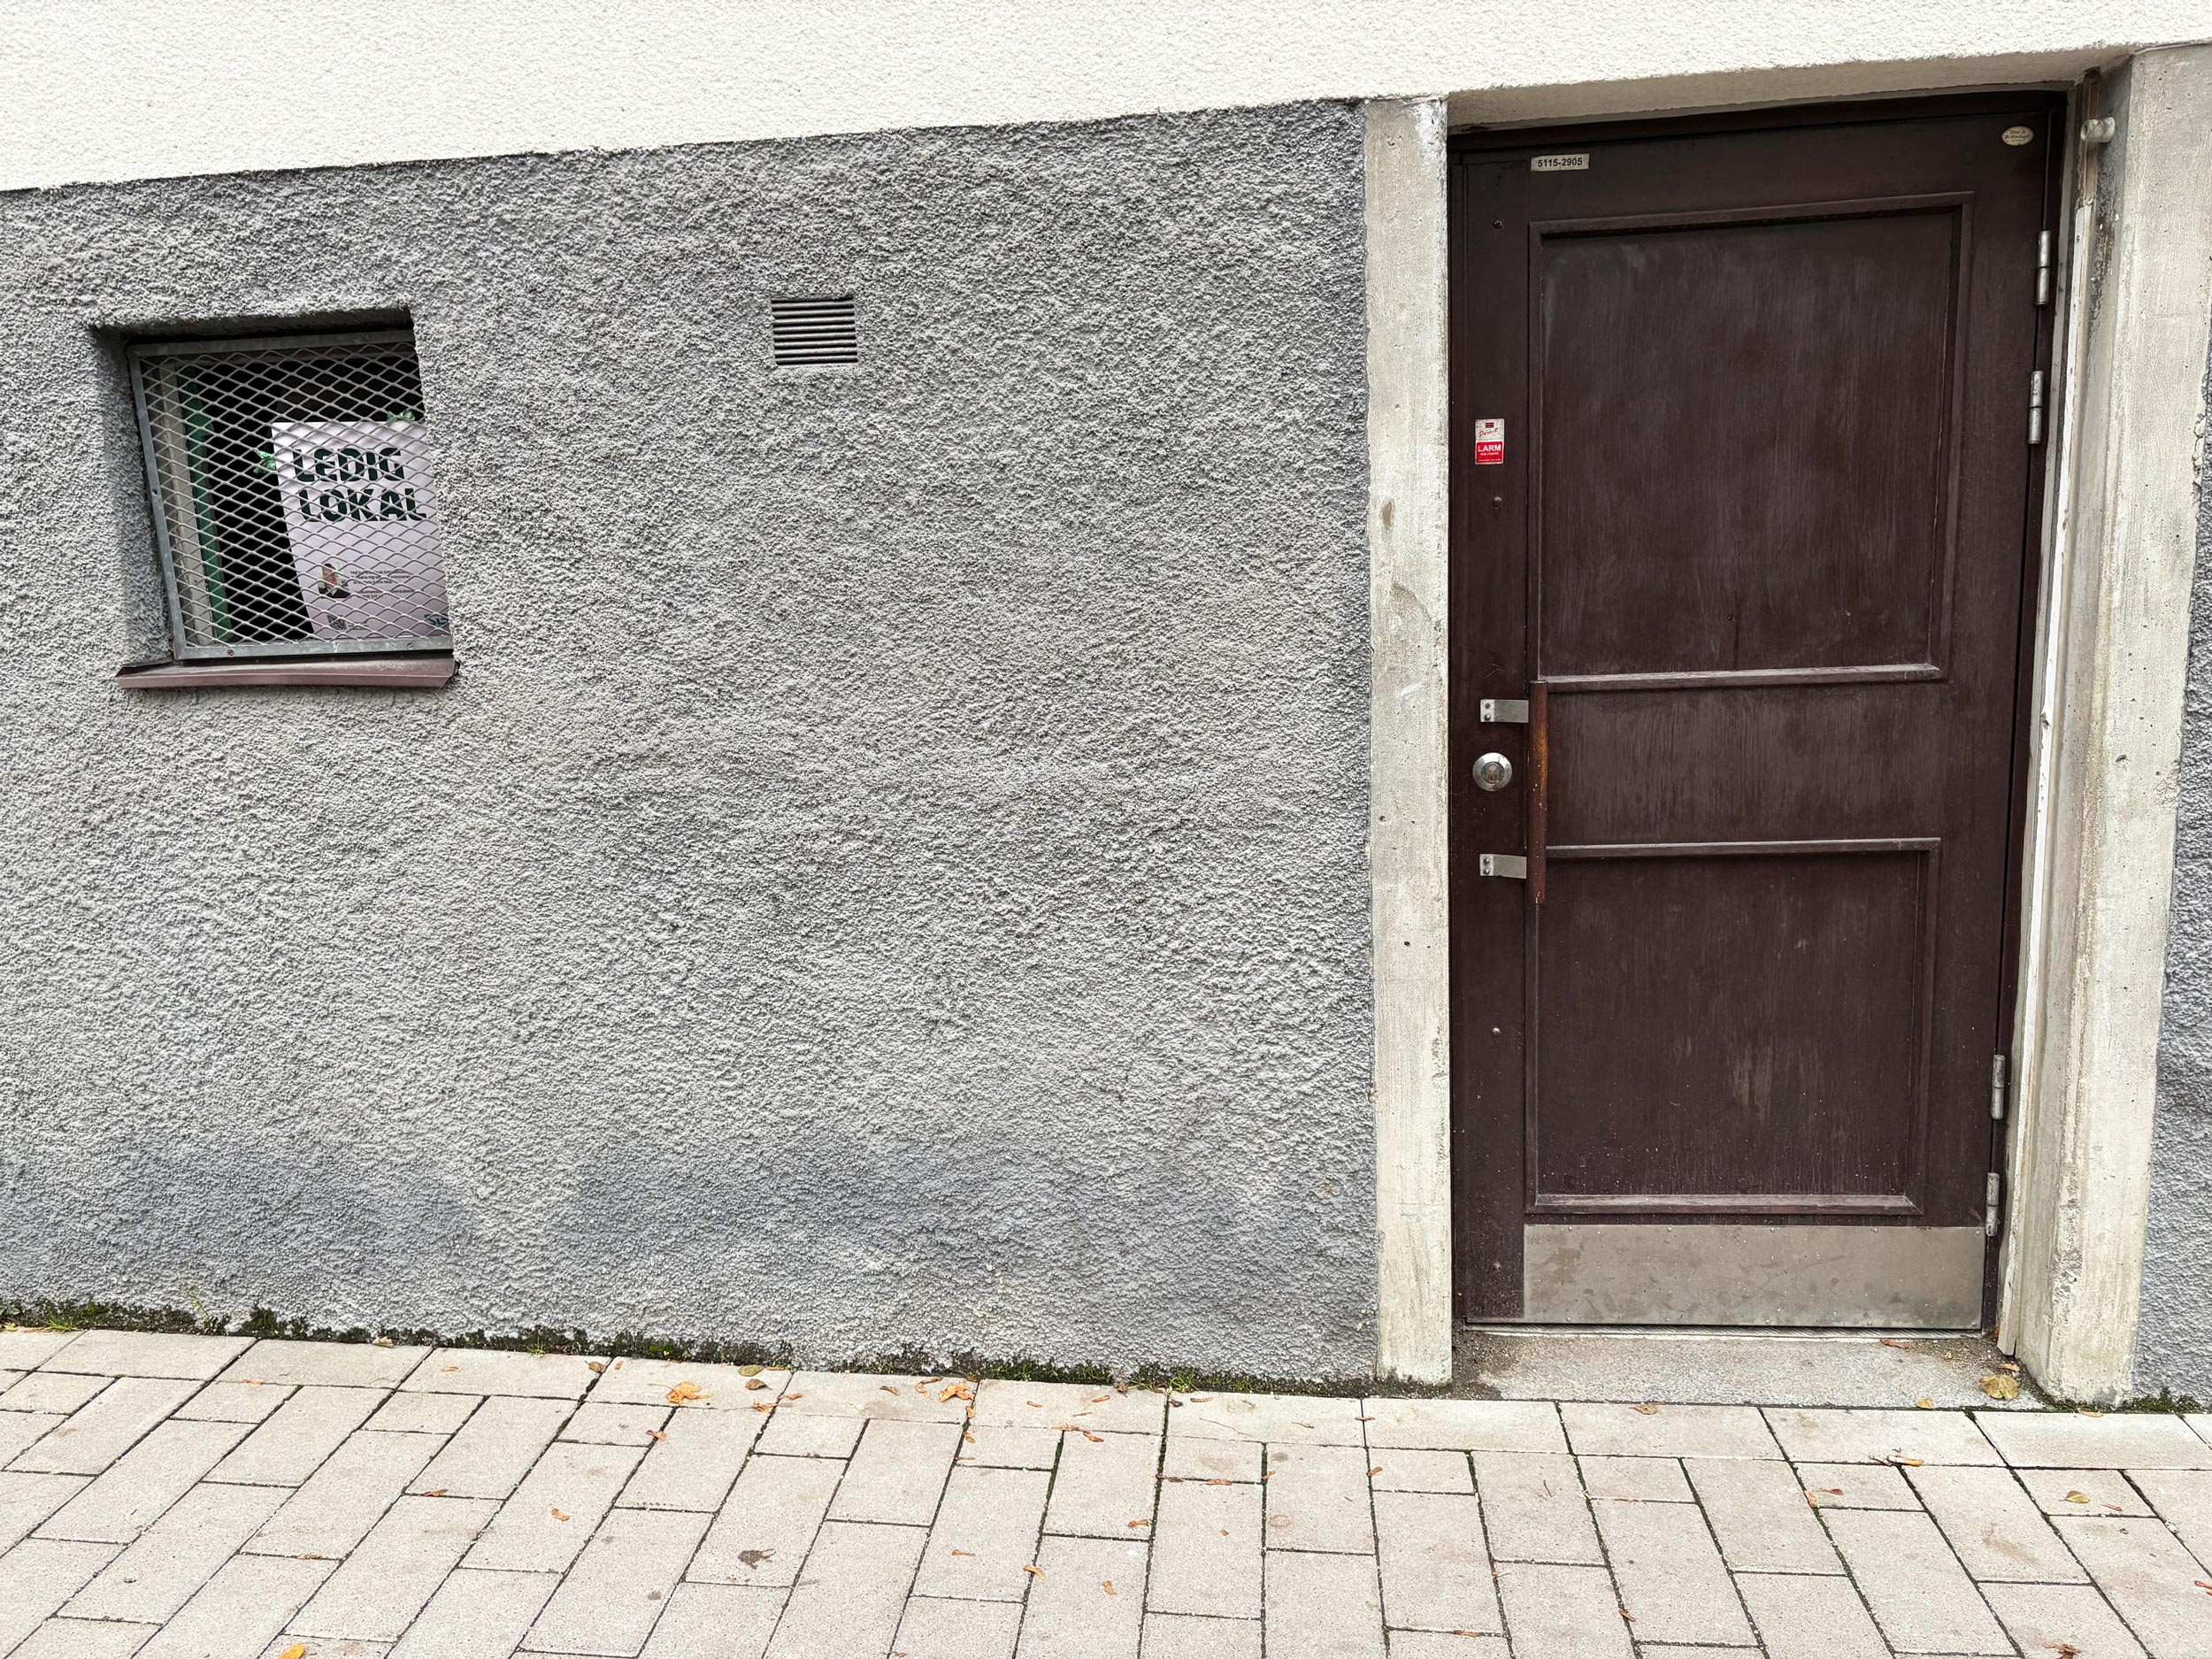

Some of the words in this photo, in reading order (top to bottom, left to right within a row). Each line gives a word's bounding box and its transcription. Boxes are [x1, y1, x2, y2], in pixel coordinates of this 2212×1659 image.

[1538, 157, 1582, 167] 5115-2905
[293, 449, 404, 481] LEDIG
[298, 488, 426, 521] LOKAL
